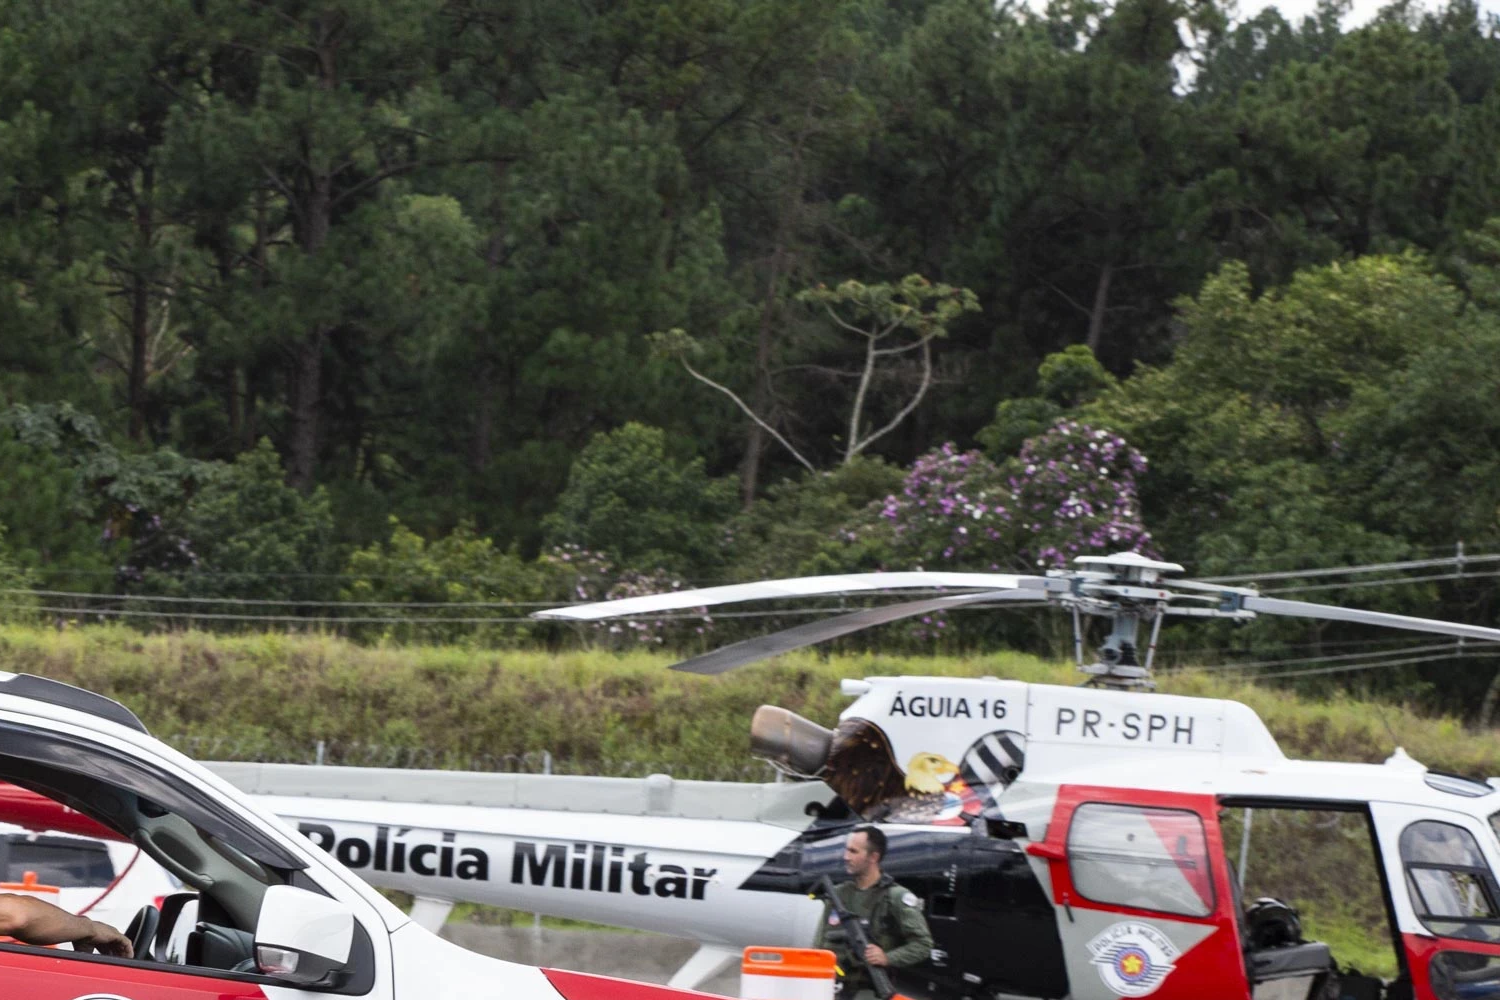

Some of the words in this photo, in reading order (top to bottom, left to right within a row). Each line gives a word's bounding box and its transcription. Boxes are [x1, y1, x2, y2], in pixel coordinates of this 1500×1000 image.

[888, 690, 972, 719] ÁGUIA
[978, 699, 1007, 720] 16
[1054, 706, 1195, 745] PR-SPH
[298, 821, 490, 882] Polícia
[510, 840, 719, 901] Militar
